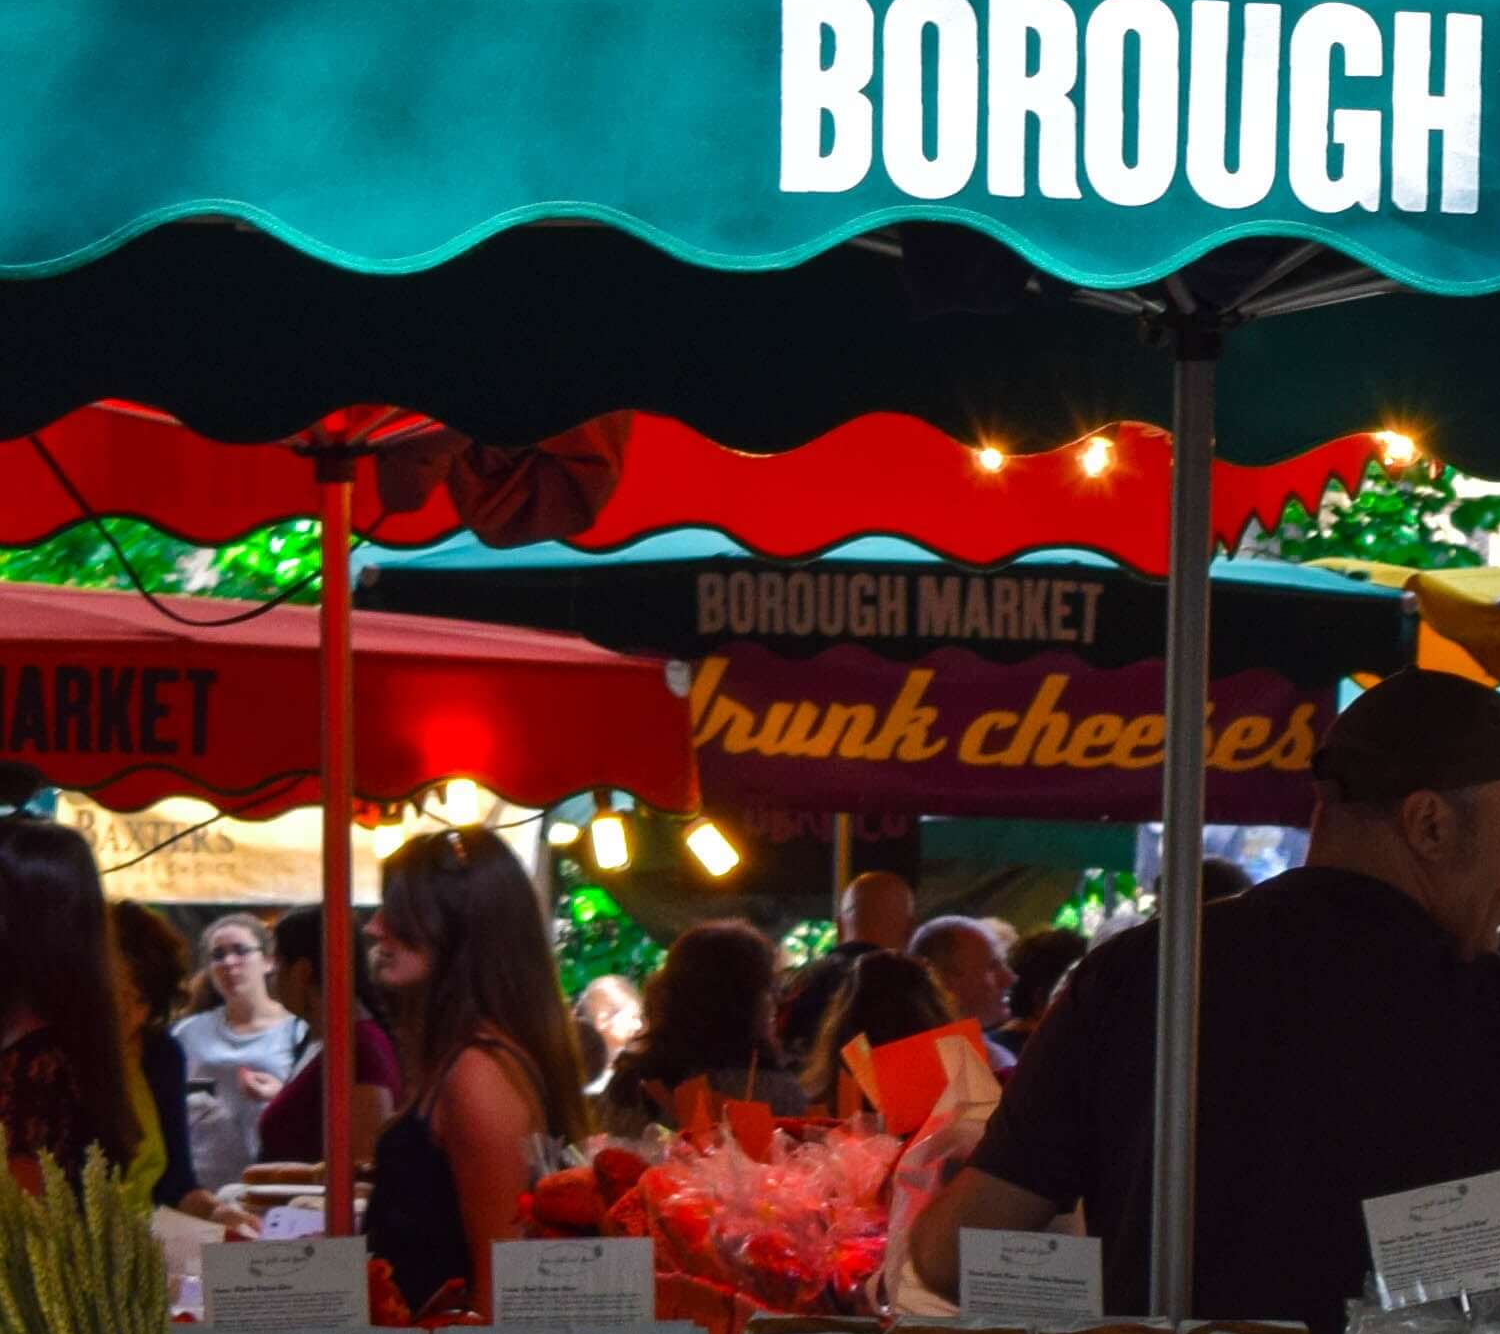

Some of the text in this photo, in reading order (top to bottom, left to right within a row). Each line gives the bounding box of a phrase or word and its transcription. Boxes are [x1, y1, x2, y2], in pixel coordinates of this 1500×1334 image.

[699, 572, 1104, 644] BOROUGH MARKET
[0, 665, 218, 757] ARKET
[957, 673, 1317, 772] cheees
